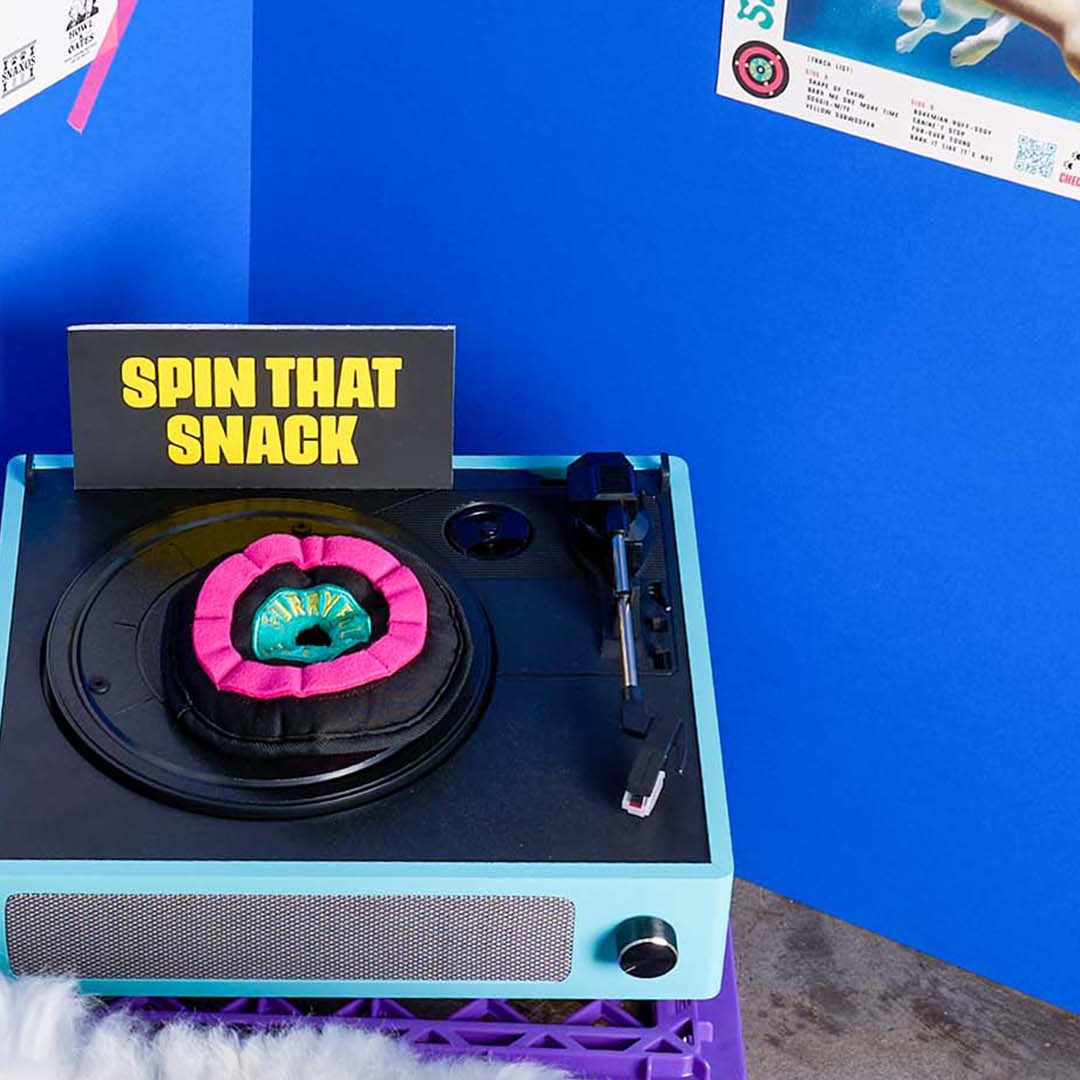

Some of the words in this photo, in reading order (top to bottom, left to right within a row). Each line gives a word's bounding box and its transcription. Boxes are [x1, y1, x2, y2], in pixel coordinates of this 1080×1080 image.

[121, 356, 257, 409] SPIN
[265, 356, 404, 409] THAT
[166, 414, 359, 466] SNACK
